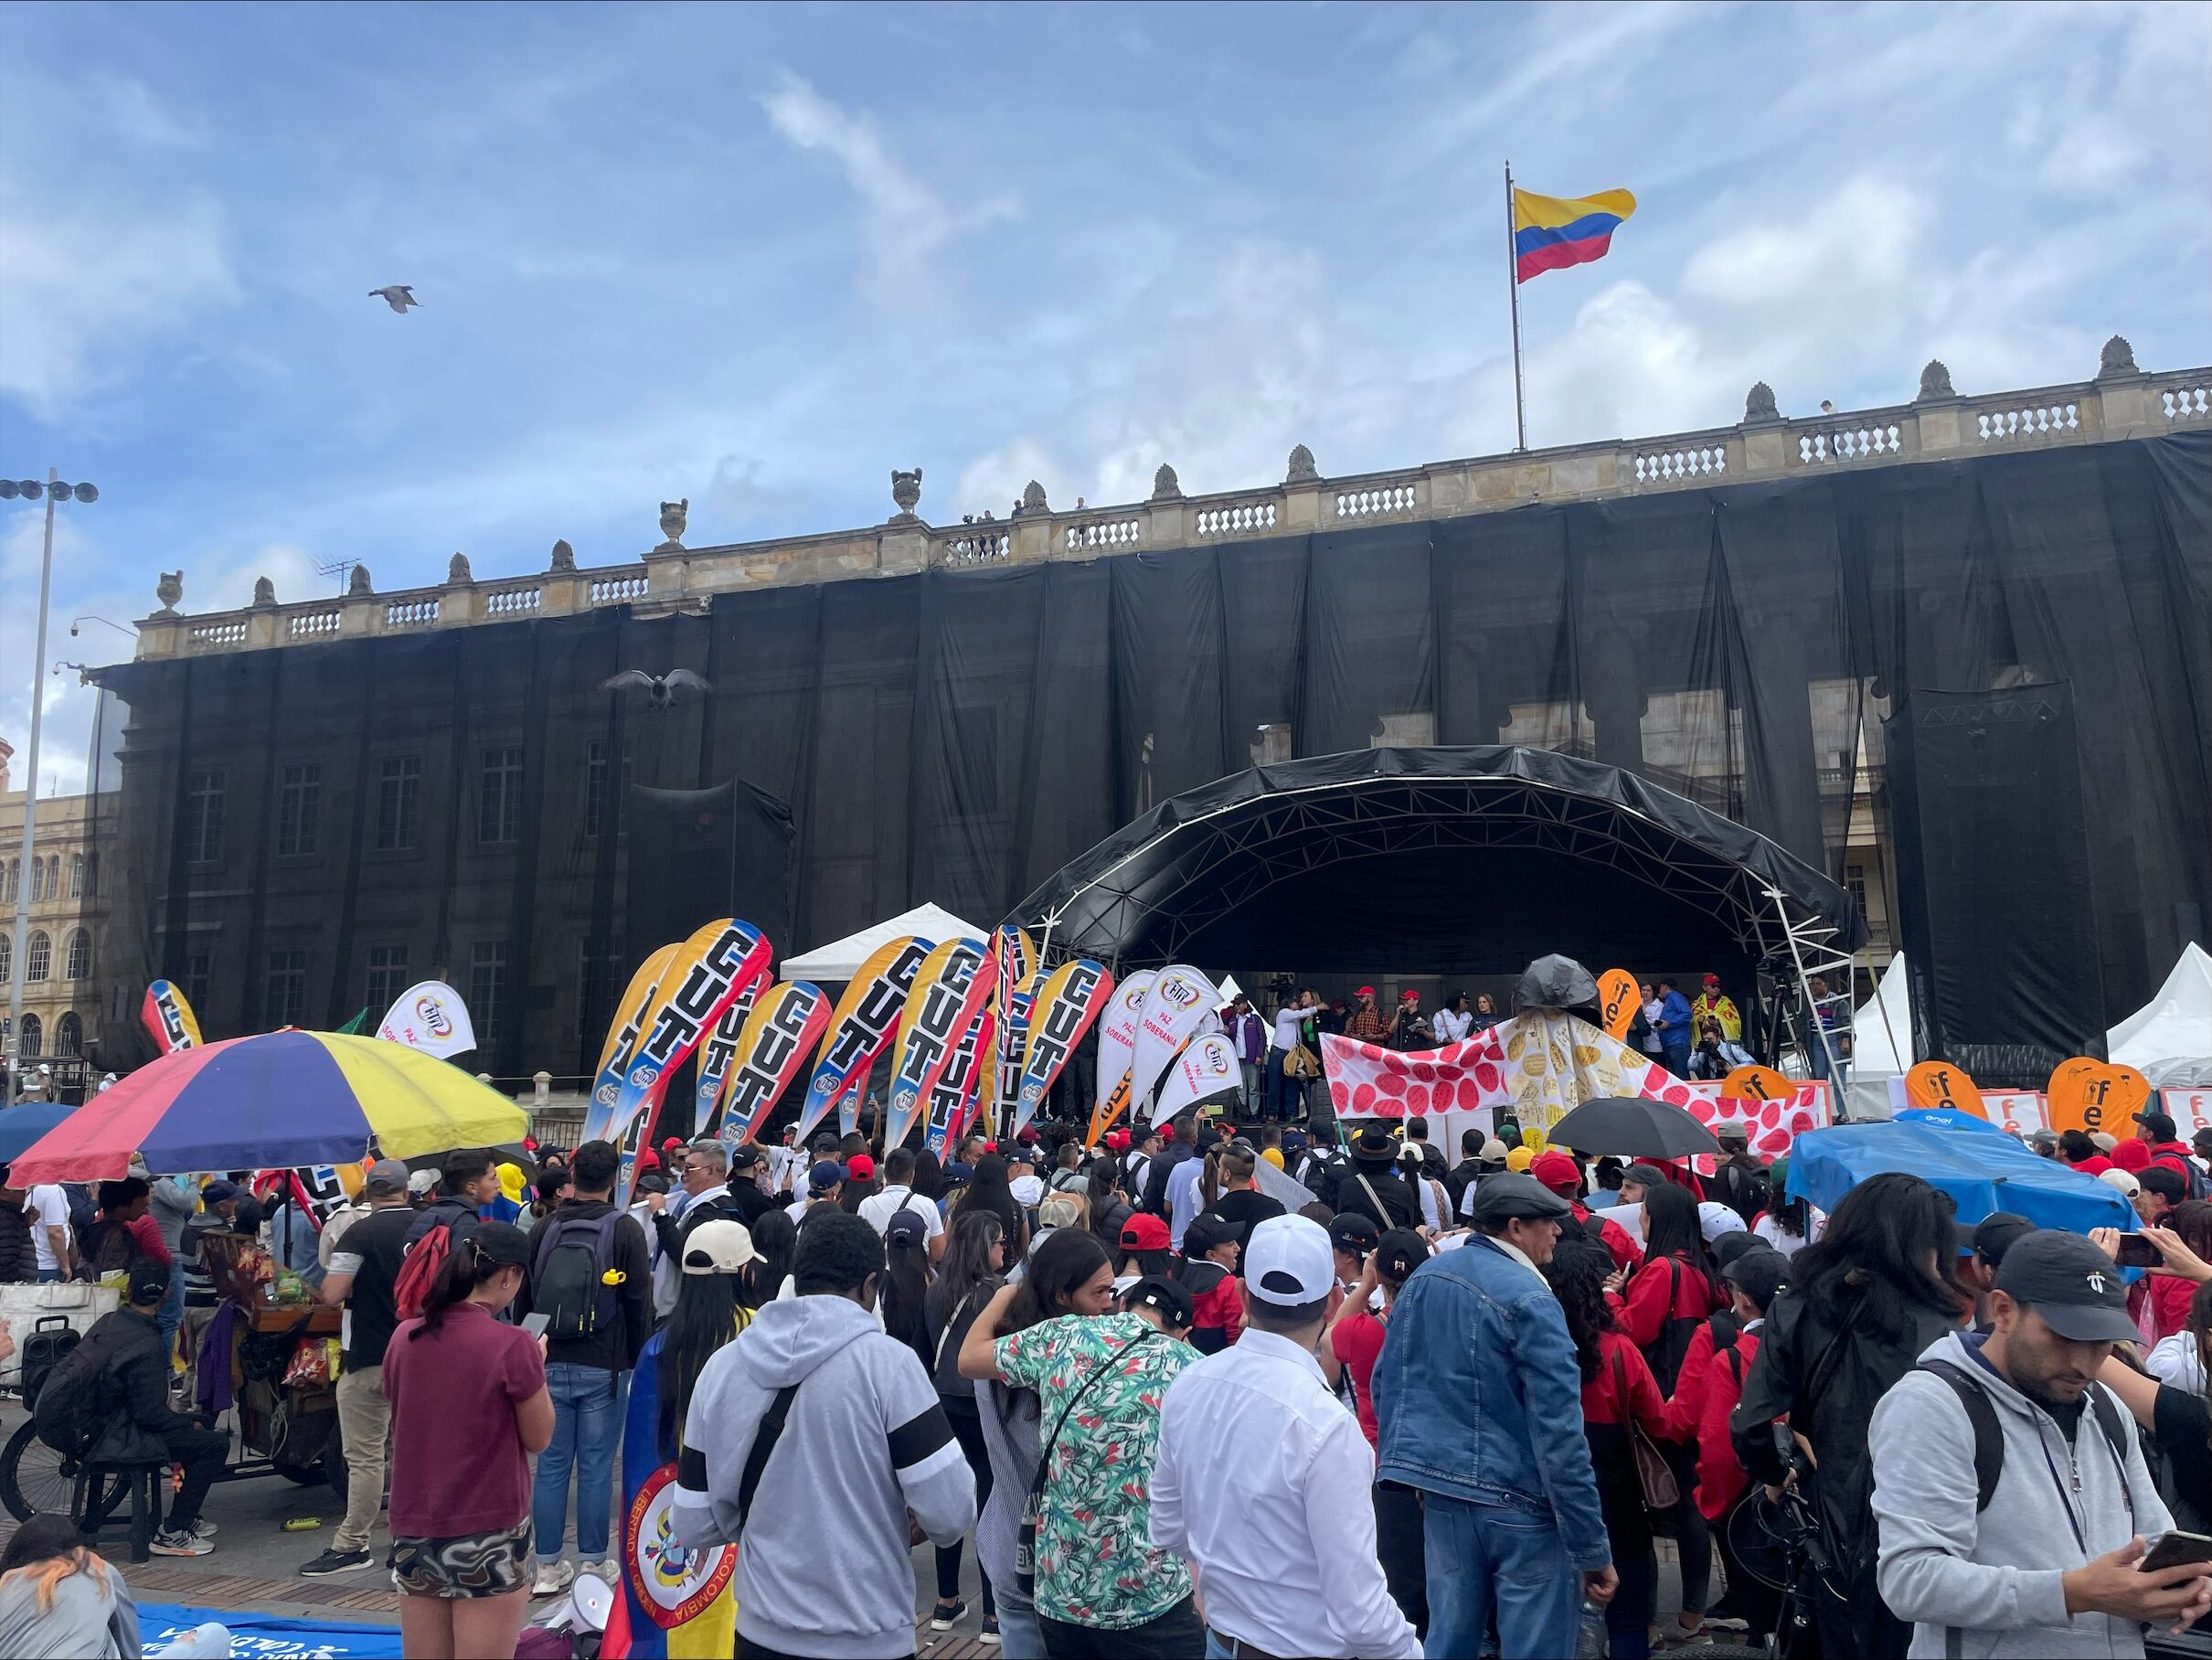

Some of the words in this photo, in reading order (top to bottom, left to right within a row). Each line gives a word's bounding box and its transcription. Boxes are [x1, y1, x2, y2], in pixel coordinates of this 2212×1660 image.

[645, 927, 756, 1063] CUT
[902, 946, 982, 1085] CUT
[1030, 965, 1101, 1080] CUT
[1122, 1021, 1136, 1034] PAZ
[1159, 1012, 1173, 1026] PAZ
[403, 1027, 418, 1044] PAZ
[729, 988, 816, 1118] CUT
[1925, 1114, 1952, 1124] enel
[627, 1487, 651, 1552] LIBERTAD
[675, 1553, 735, 1621] COLOMBIA
